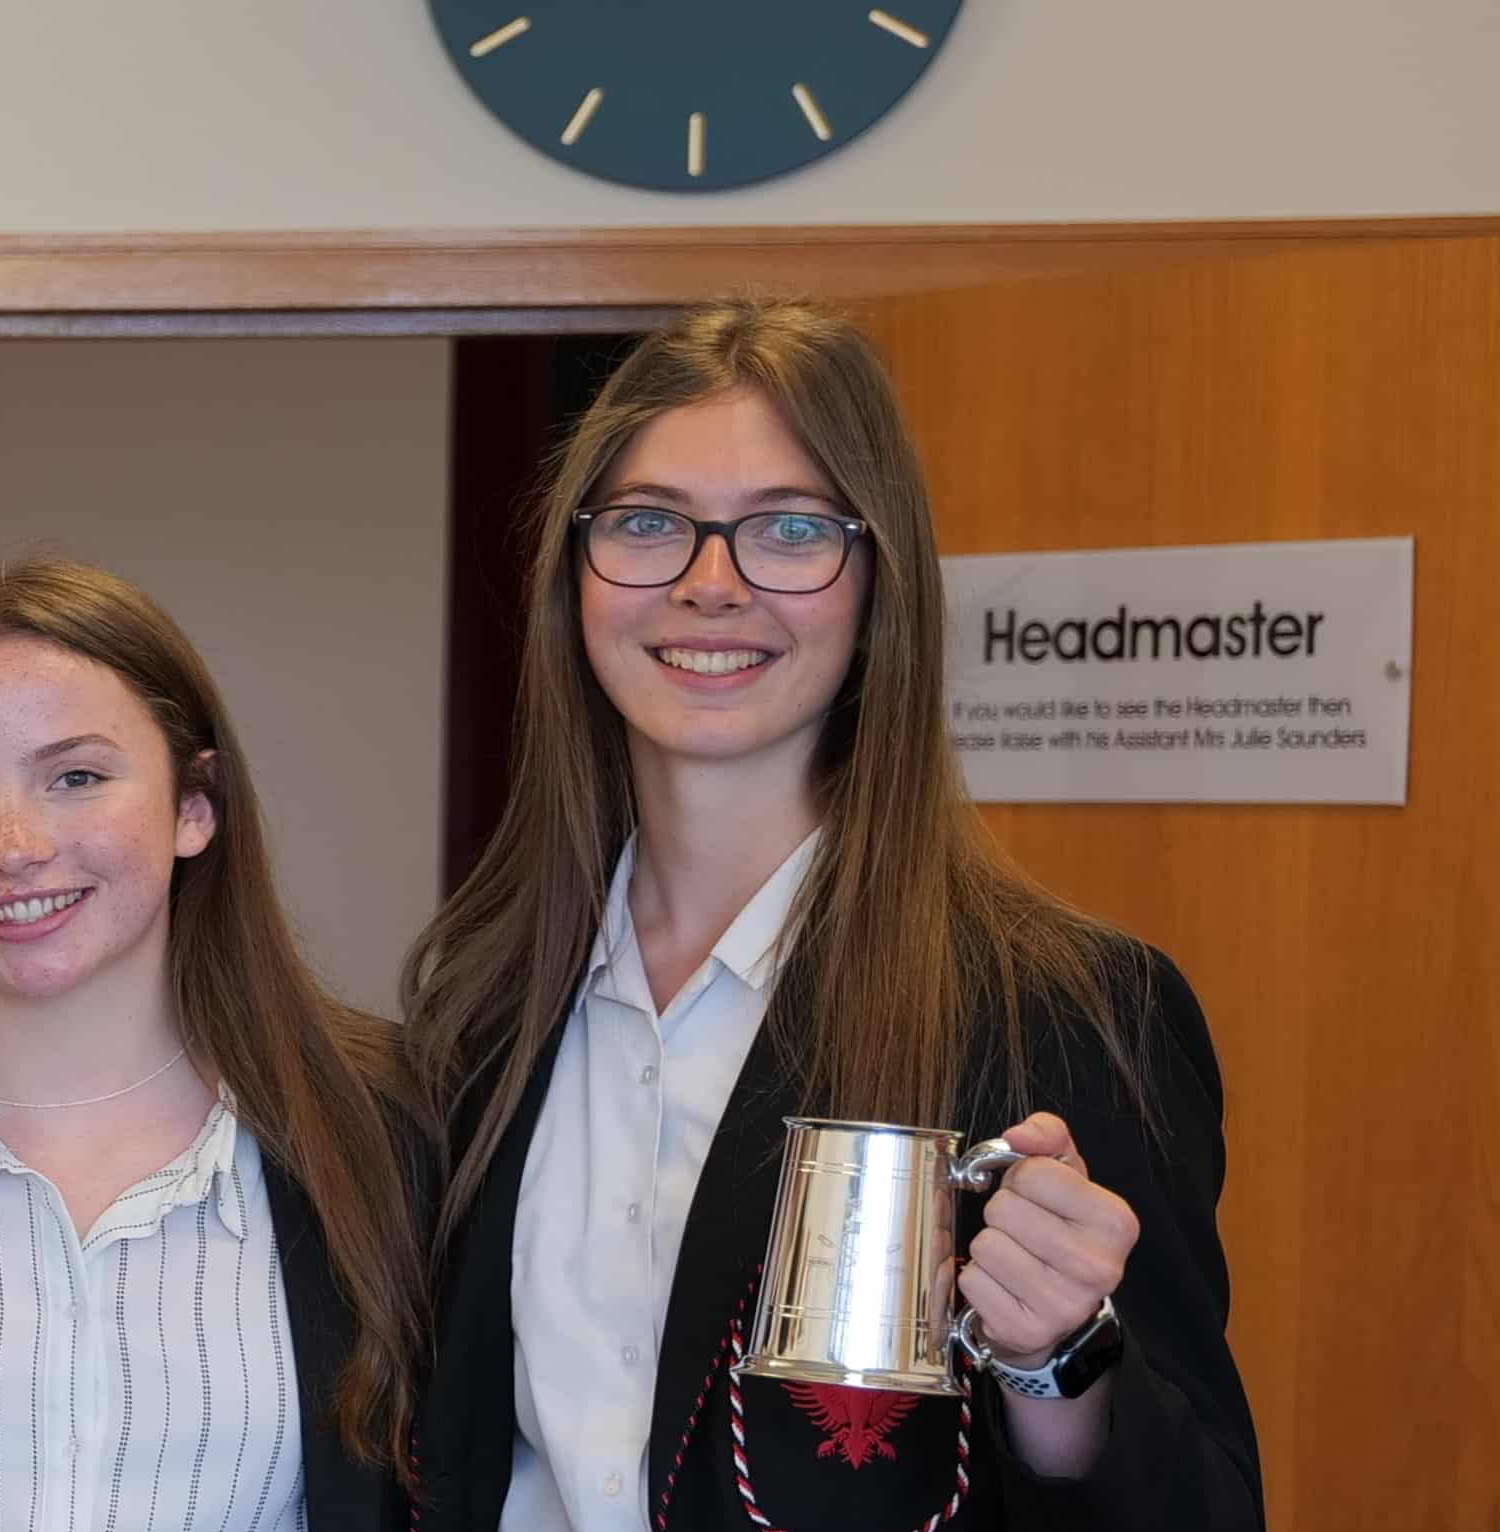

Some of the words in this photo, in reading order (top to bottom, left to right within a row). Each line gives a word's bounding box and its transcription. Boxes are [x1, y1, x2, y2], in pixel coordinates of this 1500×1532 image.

[983, 601, 1325, 664] Headmaster
[967, 703, 998, 722] you
[1003, 699, 1055, 719] would
[1060, 699, 1089, 718] like
[1093, 699, 1111, 718] to
[1116, 702, 1148, 718] see
[1153, 697, 1182, 717] the
[1186, 695, 1301, 717] Headmaster
[1307, 694, 1351, 715] then
[953, 734, 995, 747] ease
[1049, 730, 1081, 746] with
[1086, 730, 1109, 747] his
[1114, 728, 1189, 748] Assistant
[1193, 727, 1225, 746] Mrs
[1232, 727, 1271, 747] Julie
[1277, 726, 1366, 747] Saunders
